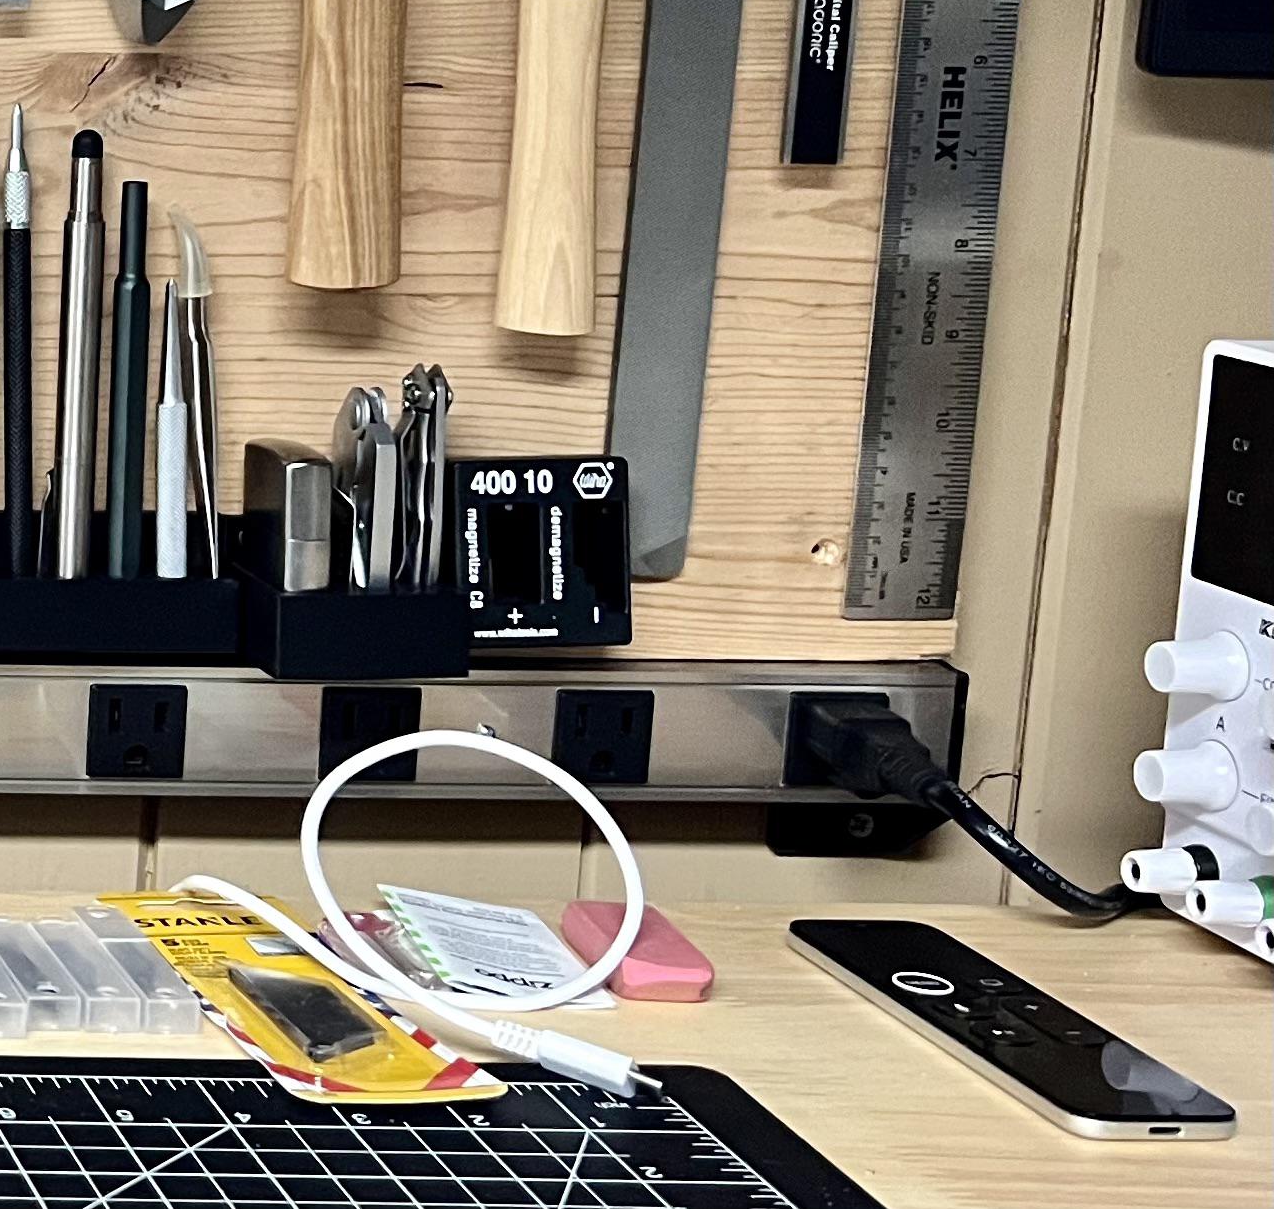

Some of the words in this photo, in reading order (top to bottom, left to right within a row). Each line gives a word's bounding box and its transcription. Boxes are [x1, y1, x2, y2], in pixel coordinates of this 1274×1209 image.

[825, 24, 842, 71] Caliper
[934, 66, 968, 163] HELIX
[921, 271, 941, 345] NON-SKID
[936, 411, 950, 431] 10
[471, 469, 517, 495] 400
[523, 469, 553, 494] 10
[903, 492, 916, 524] MADE
[465, 507, 481, 583] magnetize
[548, 506, 565, 600] demagnetize
[899, 540, 911, 564] USA
[916, 588, 932, 605] 12
[1216, 716, 1226, 732] A
[133, 915, 265, 929] STANLE
[116, 1110, 134, 1121] 5
[235, 1113, 251, 1123] 4
[352, 1113, 371, 1124] 3
[468, 1115, 490, 1126] 2
[590, 1117, 606, 1128] 1
[639, 1166, 664, 1178] 2
